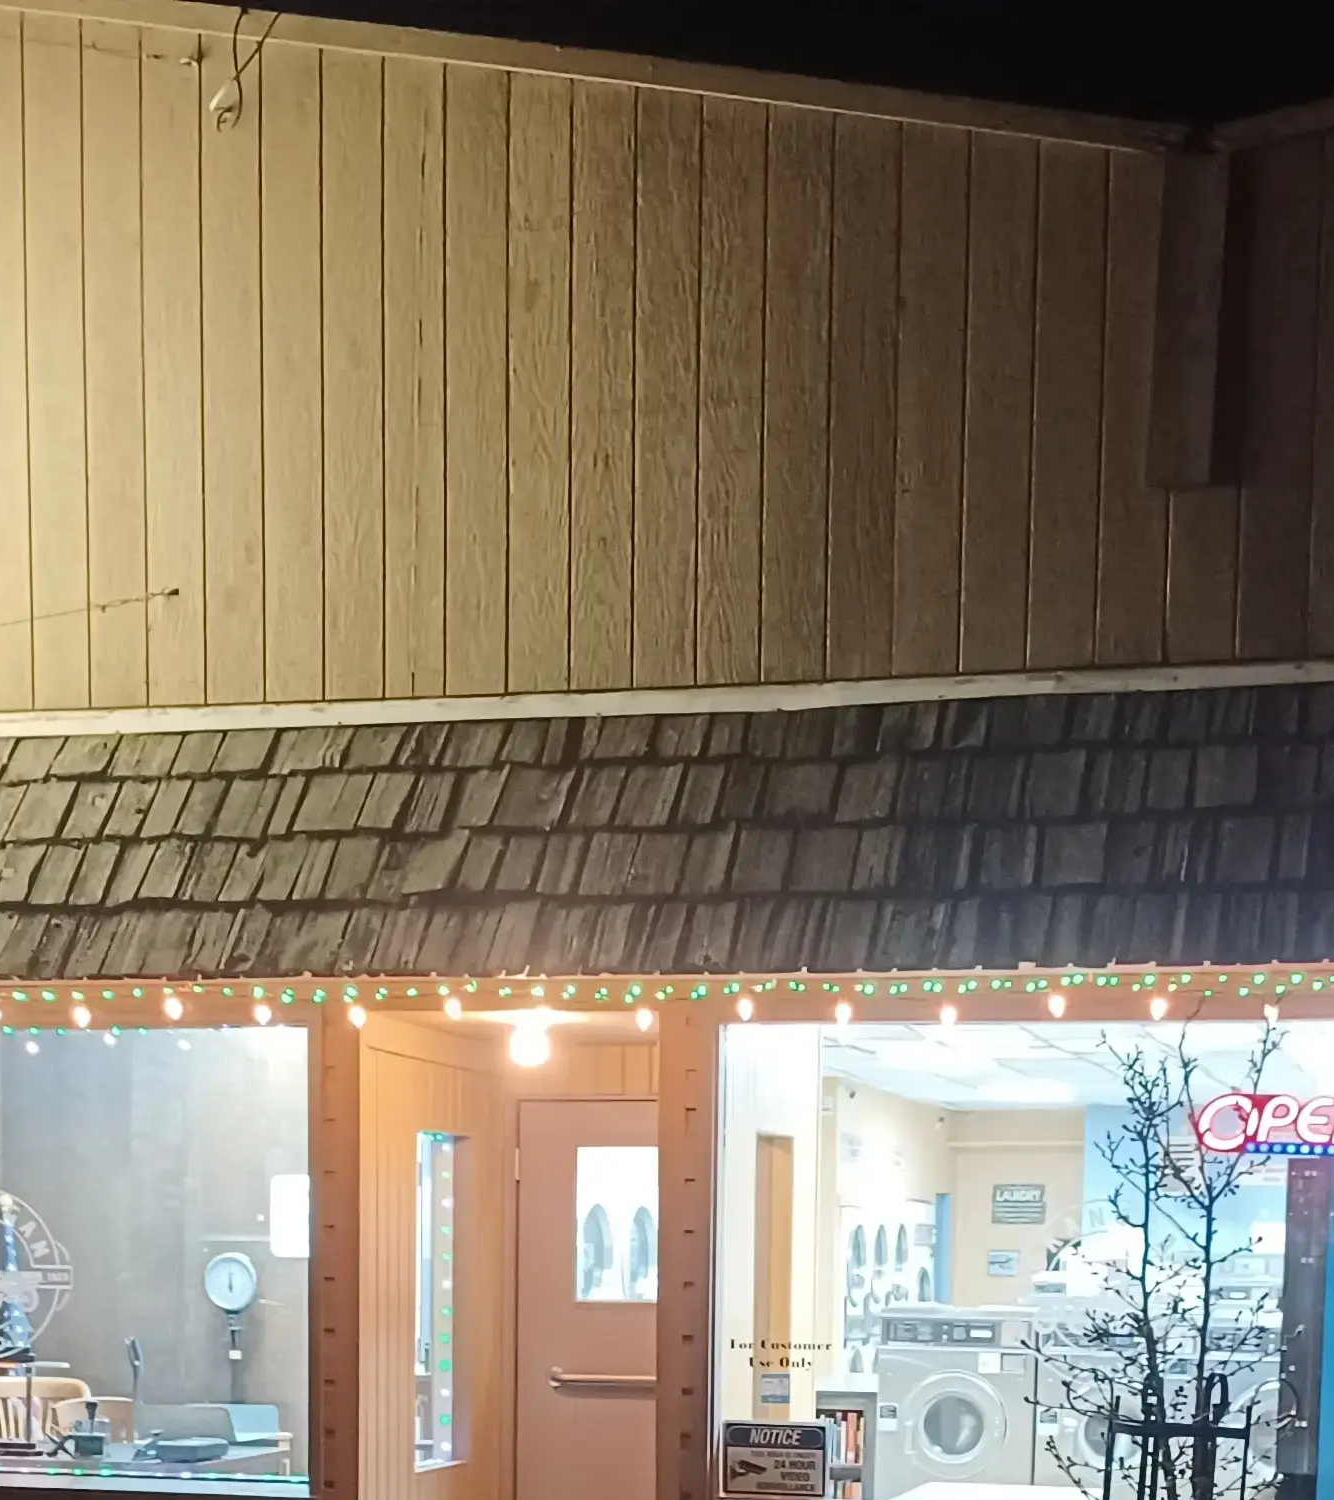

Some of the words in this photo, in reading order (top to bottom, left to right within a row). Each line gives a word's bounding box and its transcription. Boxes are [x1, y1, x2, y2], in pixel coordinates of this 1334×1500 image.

[779, 1356, 813, 1372] Only
[749, 1428, 803, 1446] NOTICE
[773, 1459, 786, 1470] 24
[789, 1460, 817, 1471] HOUR
[780, 1471, 810, 1482] VIDEO
